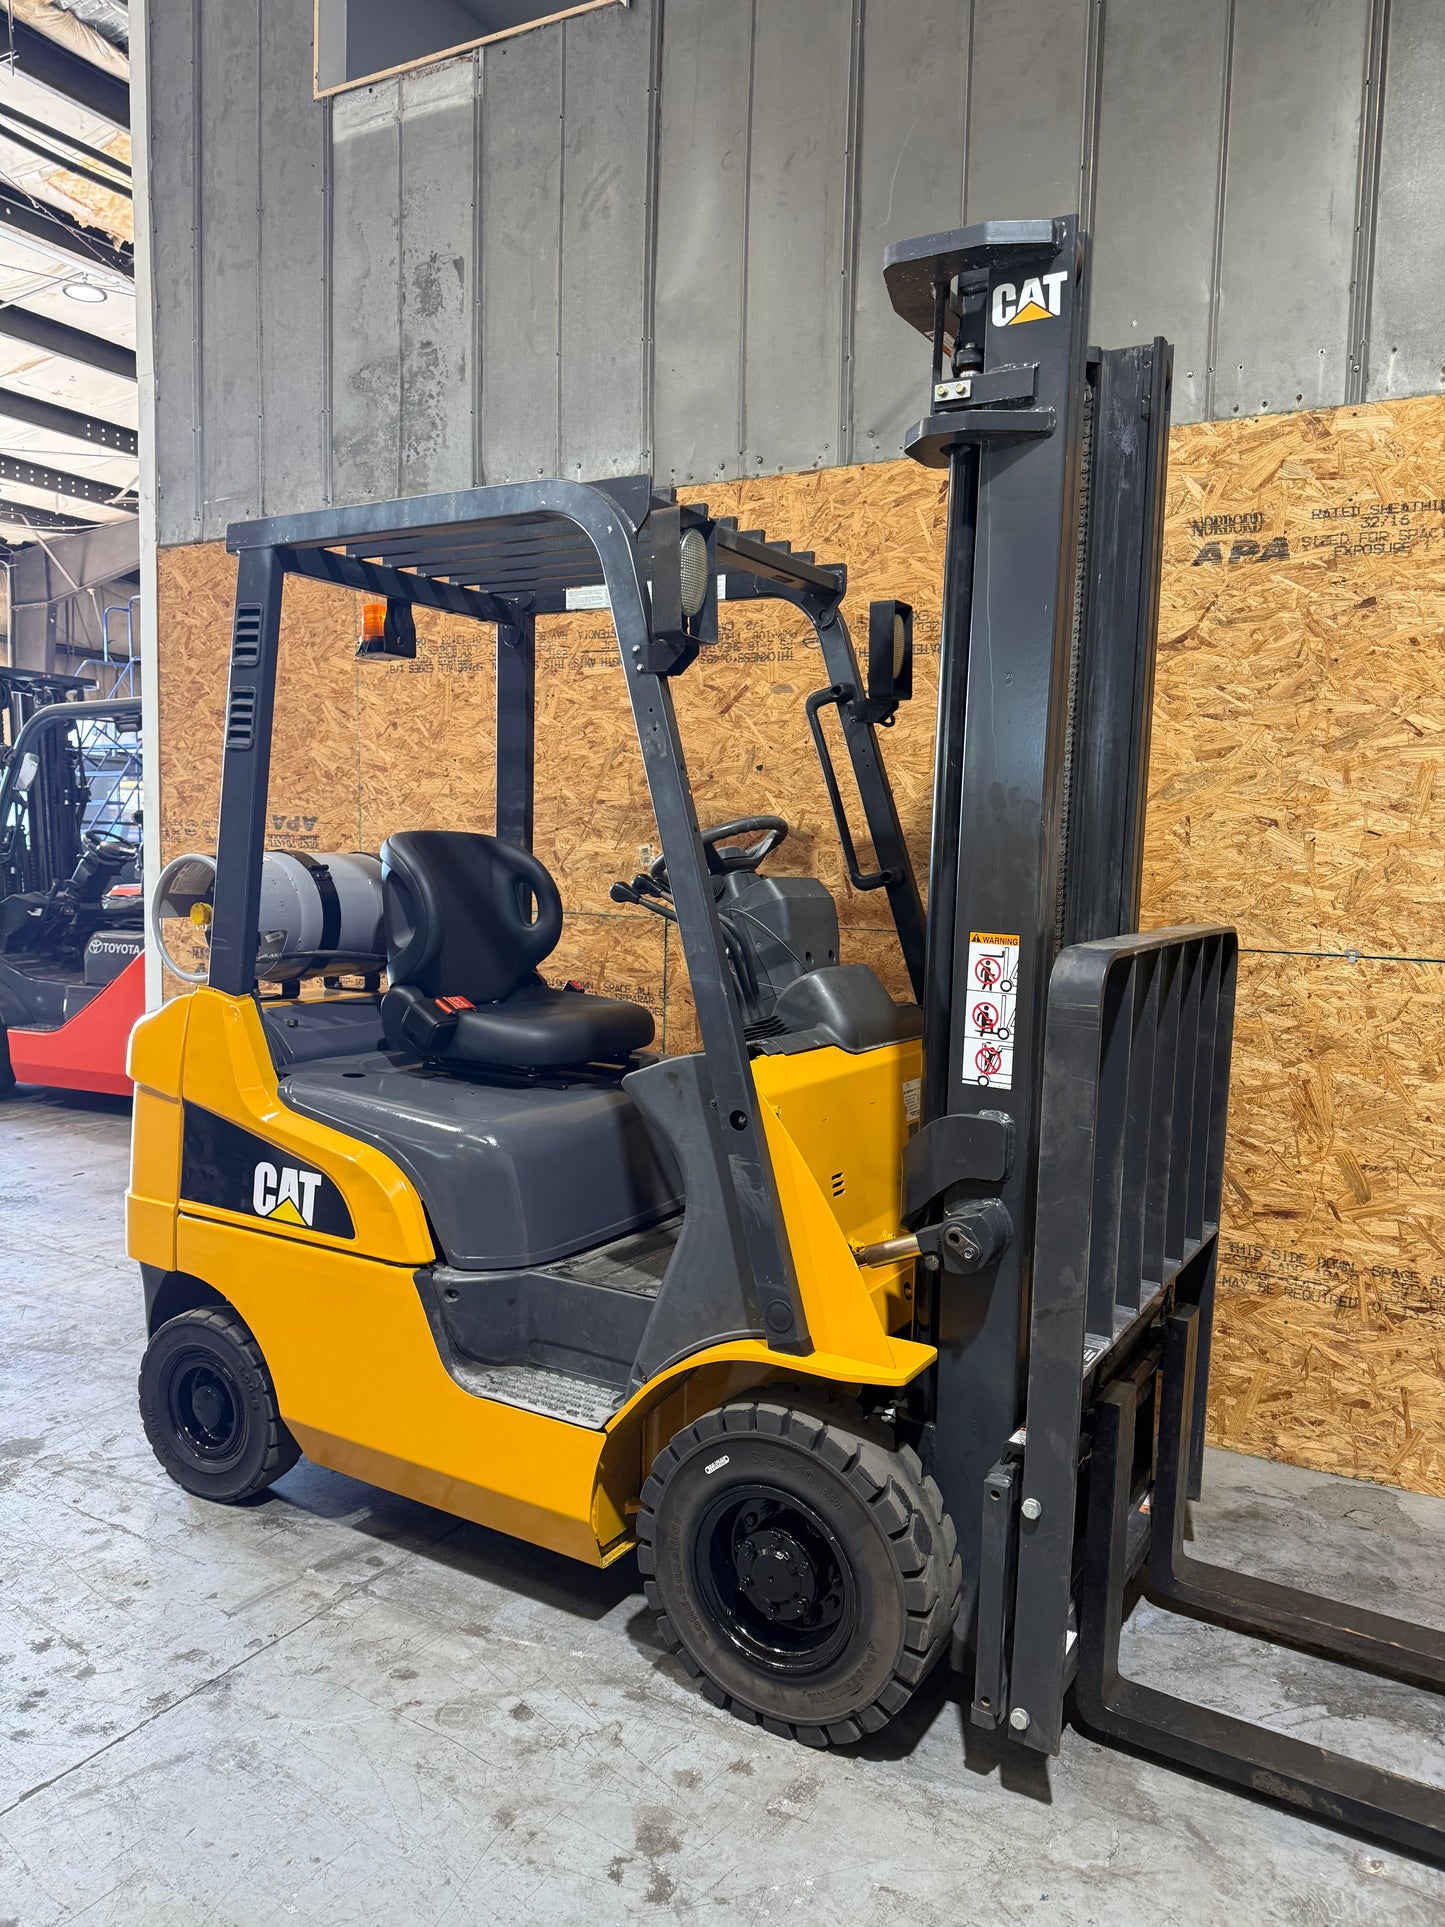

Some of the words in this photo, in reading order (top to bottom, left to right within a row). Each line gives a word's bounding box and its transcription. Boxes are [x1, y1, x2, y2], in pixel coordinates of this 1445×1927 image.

[992, 271, 1068, 327] CAT
[1359, 531, 1389, 543] FOR
[1191, 537, 1288, 567] APA
[272, 815, 318, 832] APA
[103, 943, 140, 955] TOYOTA
[983, 936, 1018, 946] WARNING
[253, 1161, 322, 1227] CAT
[1229, 1242, 1262, 1257] THIS
[1271, 1248, 1308, 1263] SIDE
[1284, 1286, 1359, 1309] REQUIRED
